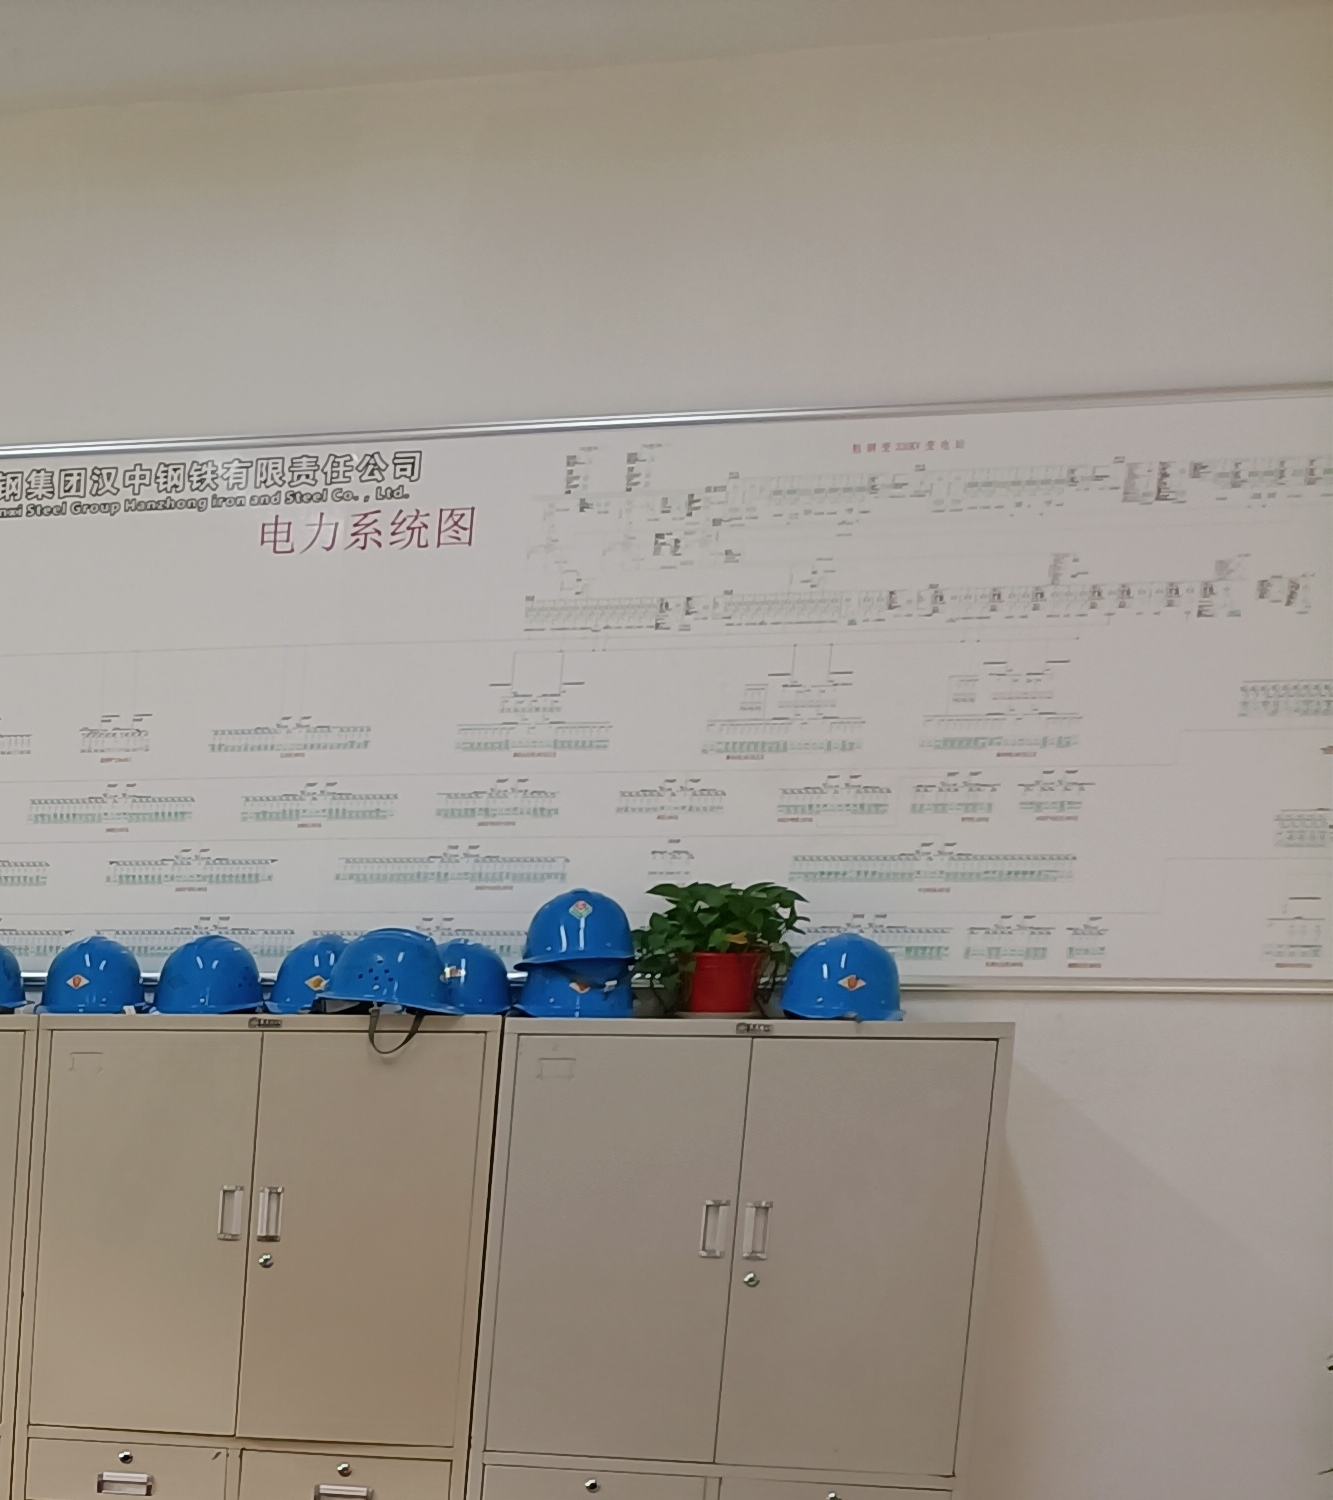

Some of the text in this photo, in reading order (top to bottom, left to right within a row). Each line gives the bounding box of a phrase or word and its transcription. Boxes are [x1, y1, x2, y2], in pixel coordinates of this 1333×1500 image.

[26, 501, 67, 517] Steel
[70, 500, 121, 516] Group
[124, 496, 209, 512] Hanzhong
[249, 490, 282, 507] and
[284, 488, 328, 505] Steel
[259, 505, 476, 556] 电力系统图
